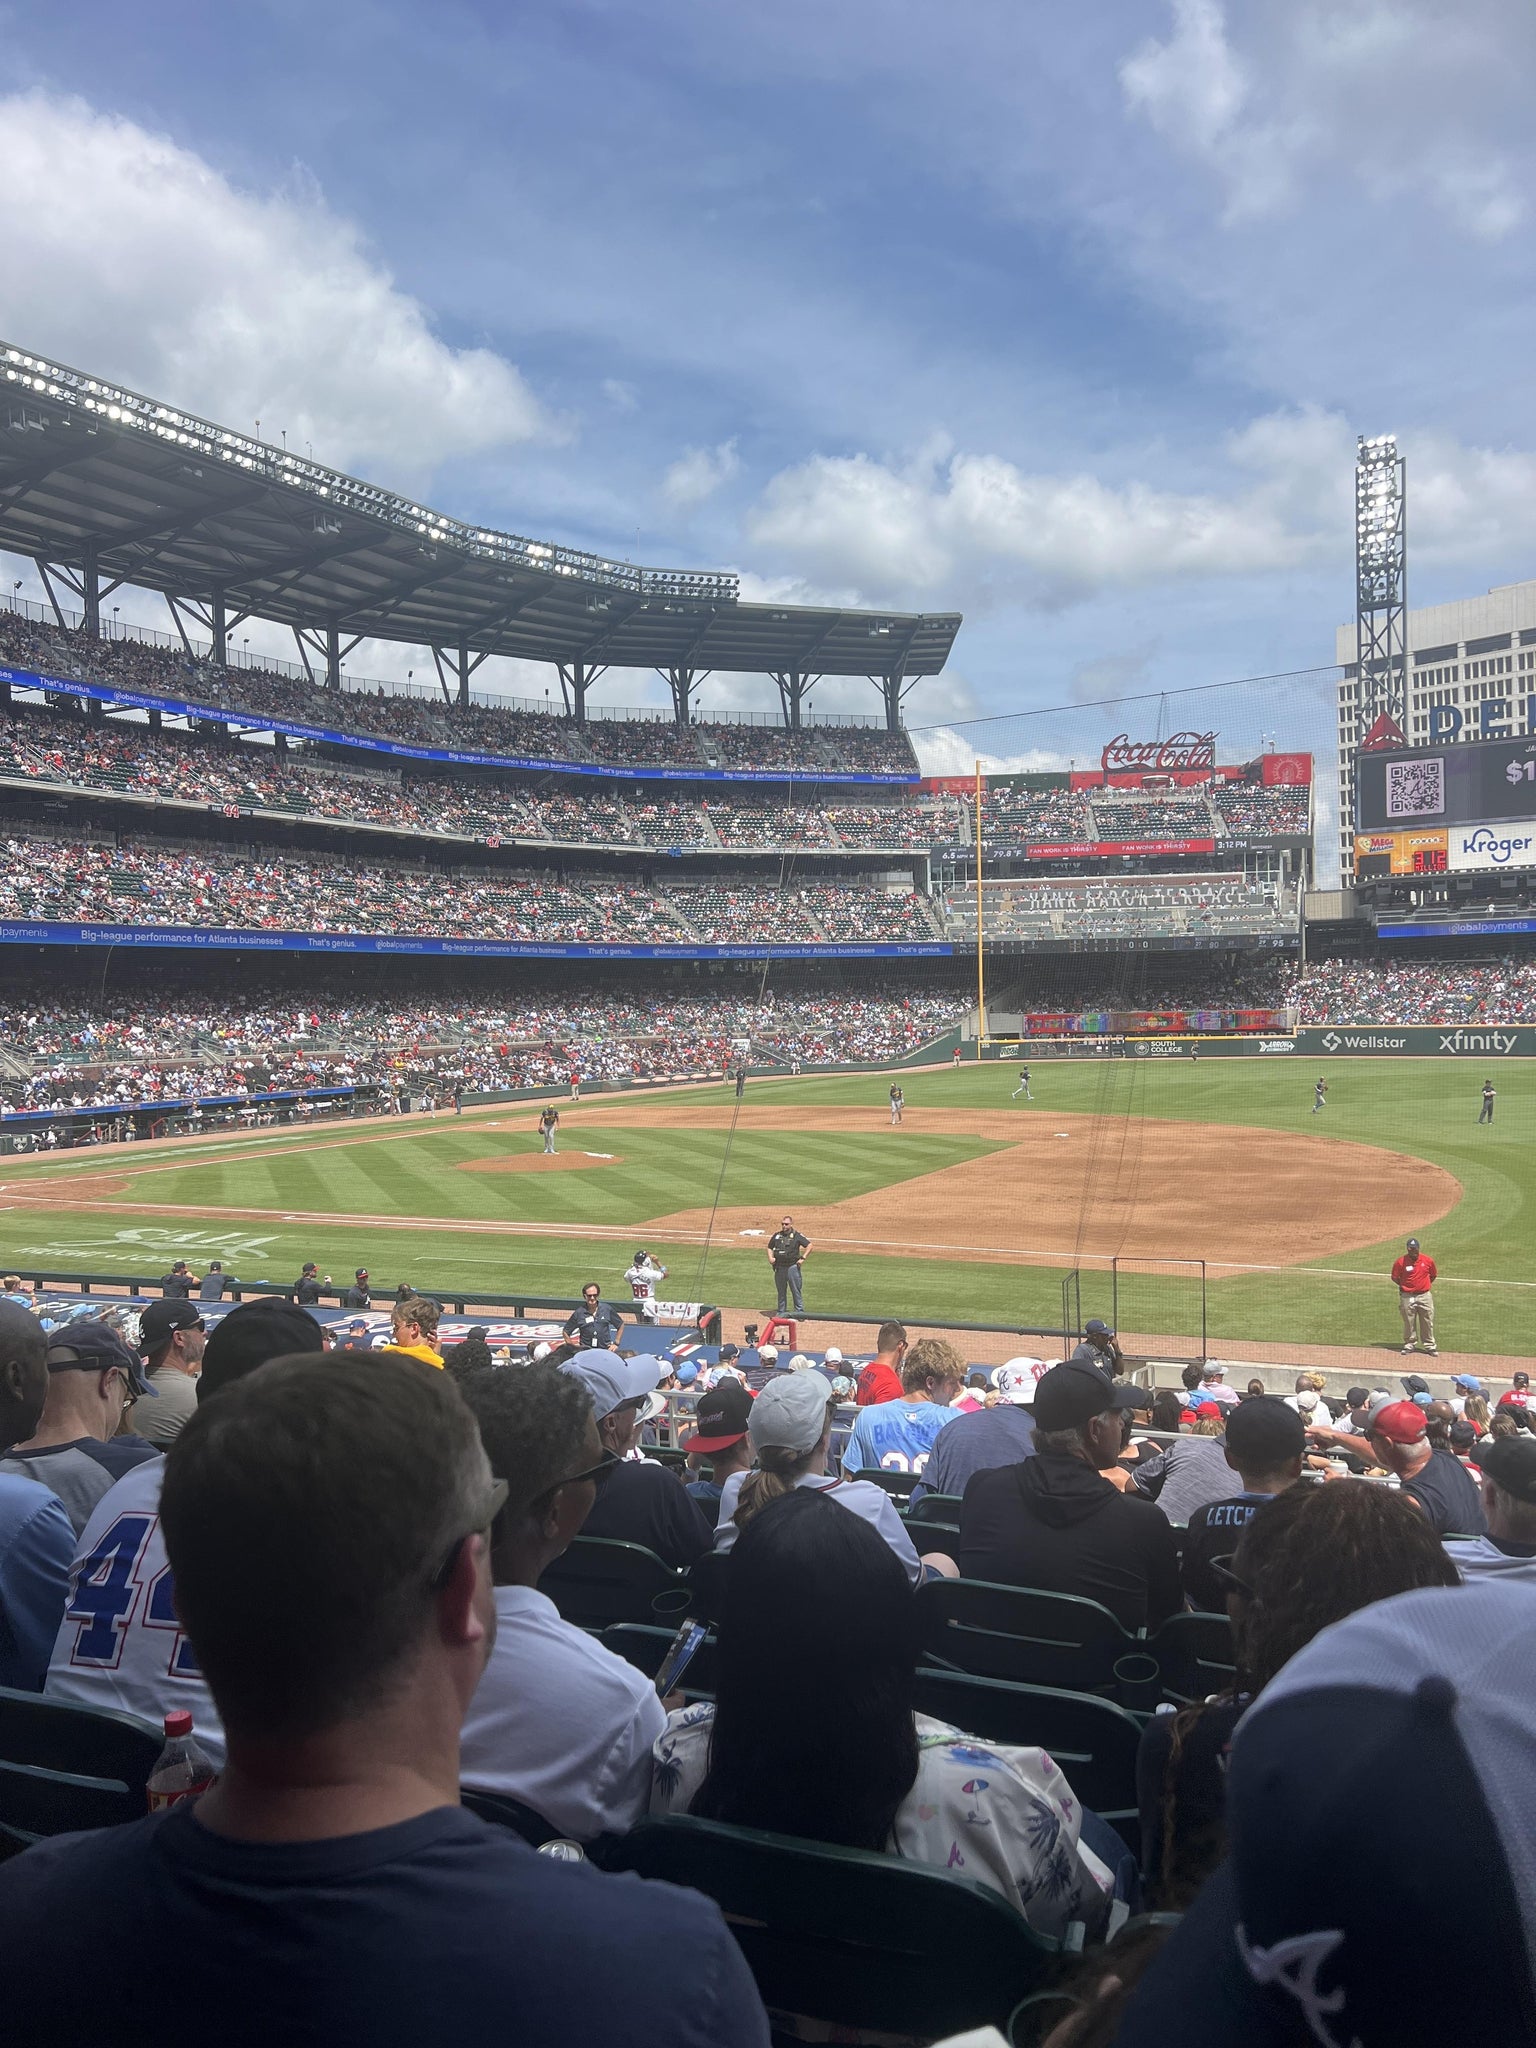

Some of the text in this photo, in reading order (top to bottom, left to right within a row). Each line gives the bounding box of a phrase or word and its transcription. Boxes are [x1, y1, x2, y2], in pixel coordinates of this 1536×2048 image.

[39, 676, 93, 694] That's genius.
[113, 691, 165, 707] globalpayments
[186, 704, 325, 738] Big-league performance for Atlanta businesses
[341, 734, 358, 745] That's
[448, 751, 481, 763] Big-league
[481, 755, 519, 766] performance
[519, 758, 528, 766] for
[529, 759, 549, 768] Atlanta
[598, 766, 636, 777] That's genius.
[723, 771, 754, 781] Big-league
[754, 772, 792, 781] performance
[222, 803, 239, 818] 44
[1163, 842, 1191, 850] THIRSTY
[1217, 841, 1234, 849] 3:12
[1371, 838, 1394, 846] MEGA
[1463, 828, 1532, 862] Kroger
[993, 850, 1012, 858] 79.8
[1070, 845, 1098, 853] THIRSTY
[1030, 887, 1246, 910] HANK AARON TERRACE
[1449, 921, 1529, 934] globalpayments
[81, 930, 283, 945] Big-league performance for Atlanta businesses
[1272, 939, 1284, 947] 95
[308, 938, 357, 949] That's genius.
[442, 943, 567, 955] Big-league performance for Atlanta businesses
[588, 947, 633, 956] That's genius.
[718, 948, 757, 957] Big-league
[758, 948, 801, 957] performance
[812, 947, 837, 955] Atlanta
[917, 946, 942, 954] genius.
[1344, 1036, 1407, 1048] Wellstar
[1439, 1029, 1518, 1053] xfinity
